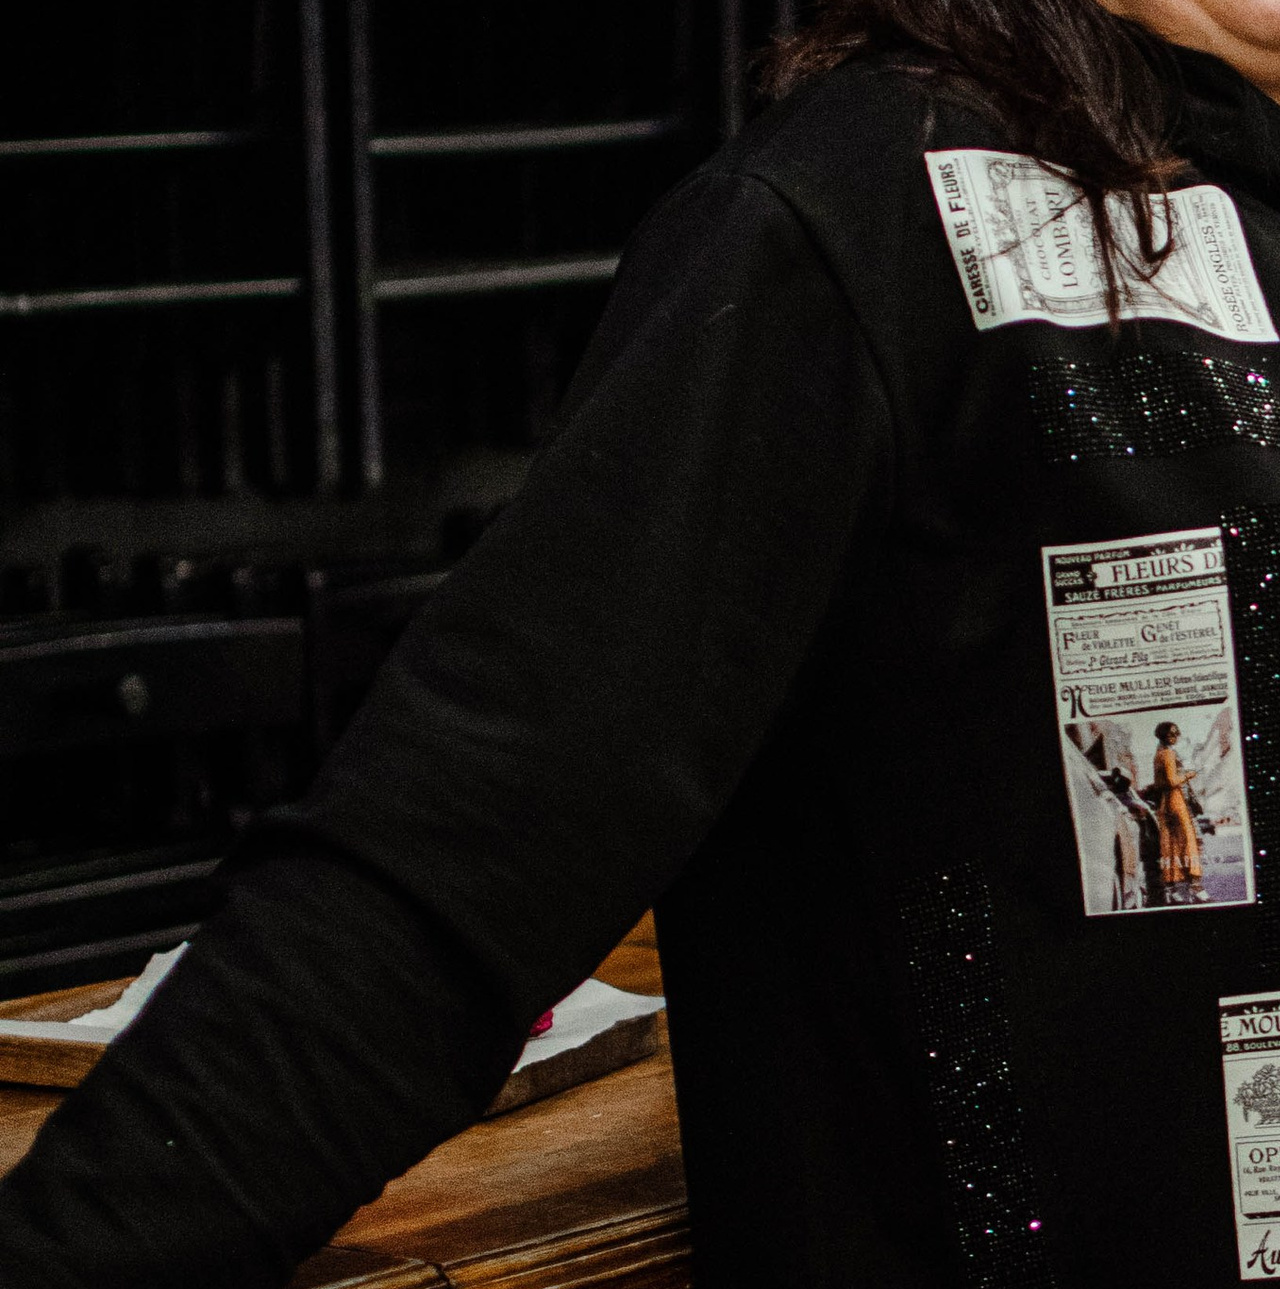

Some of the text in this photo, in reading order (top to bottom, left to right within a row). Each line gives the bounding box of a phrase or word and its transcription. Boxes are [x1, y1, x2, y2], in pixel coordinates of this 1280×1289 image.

[938, 163, 989, 314] CARESSE DE FLEURS
[1026, 198, 1051, 280] CHOCOLAT
[1045, 189, 1078, 287] LOMBART
[1201, 225, 1229, 283] ONGLES
[1221, 287, 1248, 332] ROSÉE
[1112, 554, 1194, 583] FLEURS
